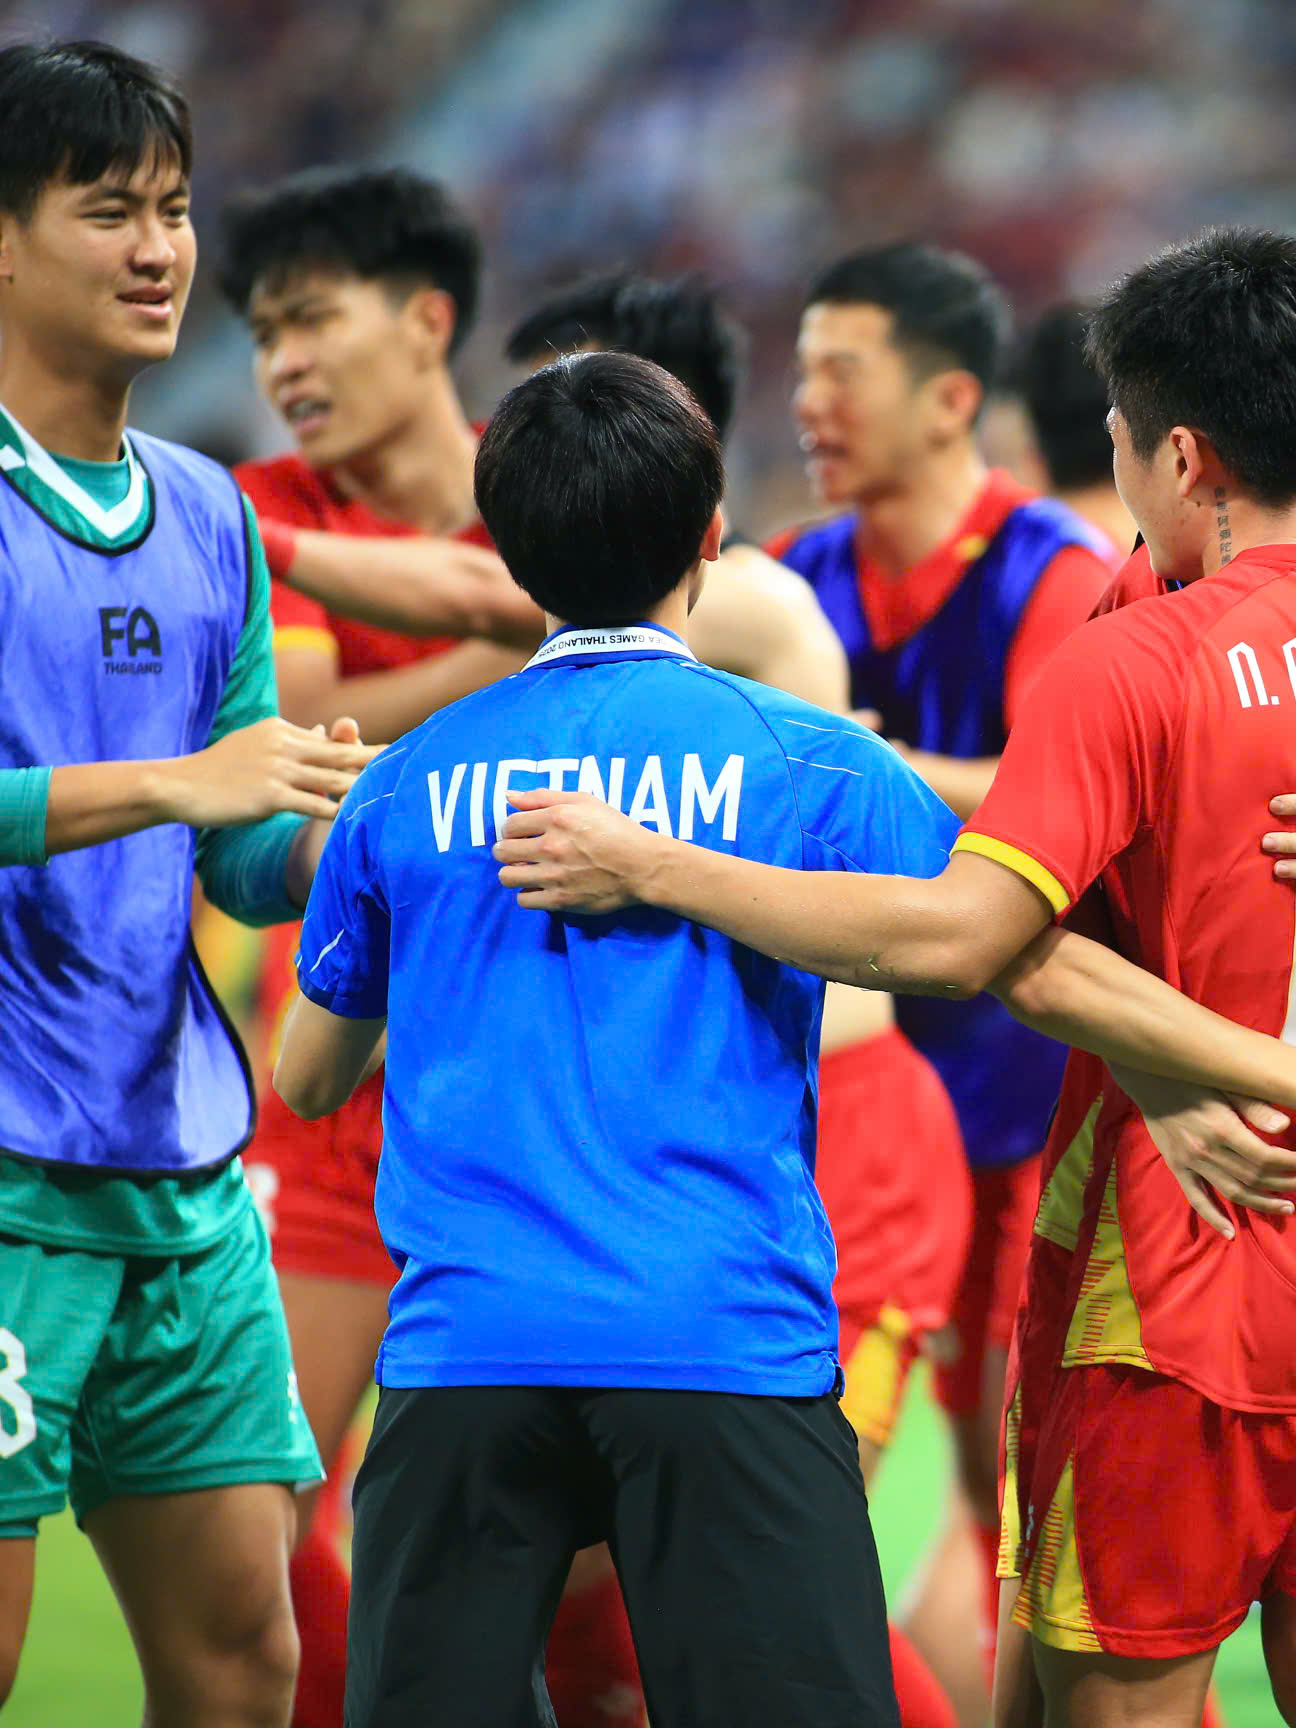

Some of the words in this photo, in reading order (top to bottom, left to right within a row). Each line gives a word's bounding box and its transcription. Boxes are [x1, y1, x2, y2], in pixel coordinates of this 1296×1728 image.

[98, 606, 162, 658] FA
[558, 635, 606, 649] THAILAND
[609, 634, 645, 644] GAMES
[103, 662, 163, 675] THAILAND
